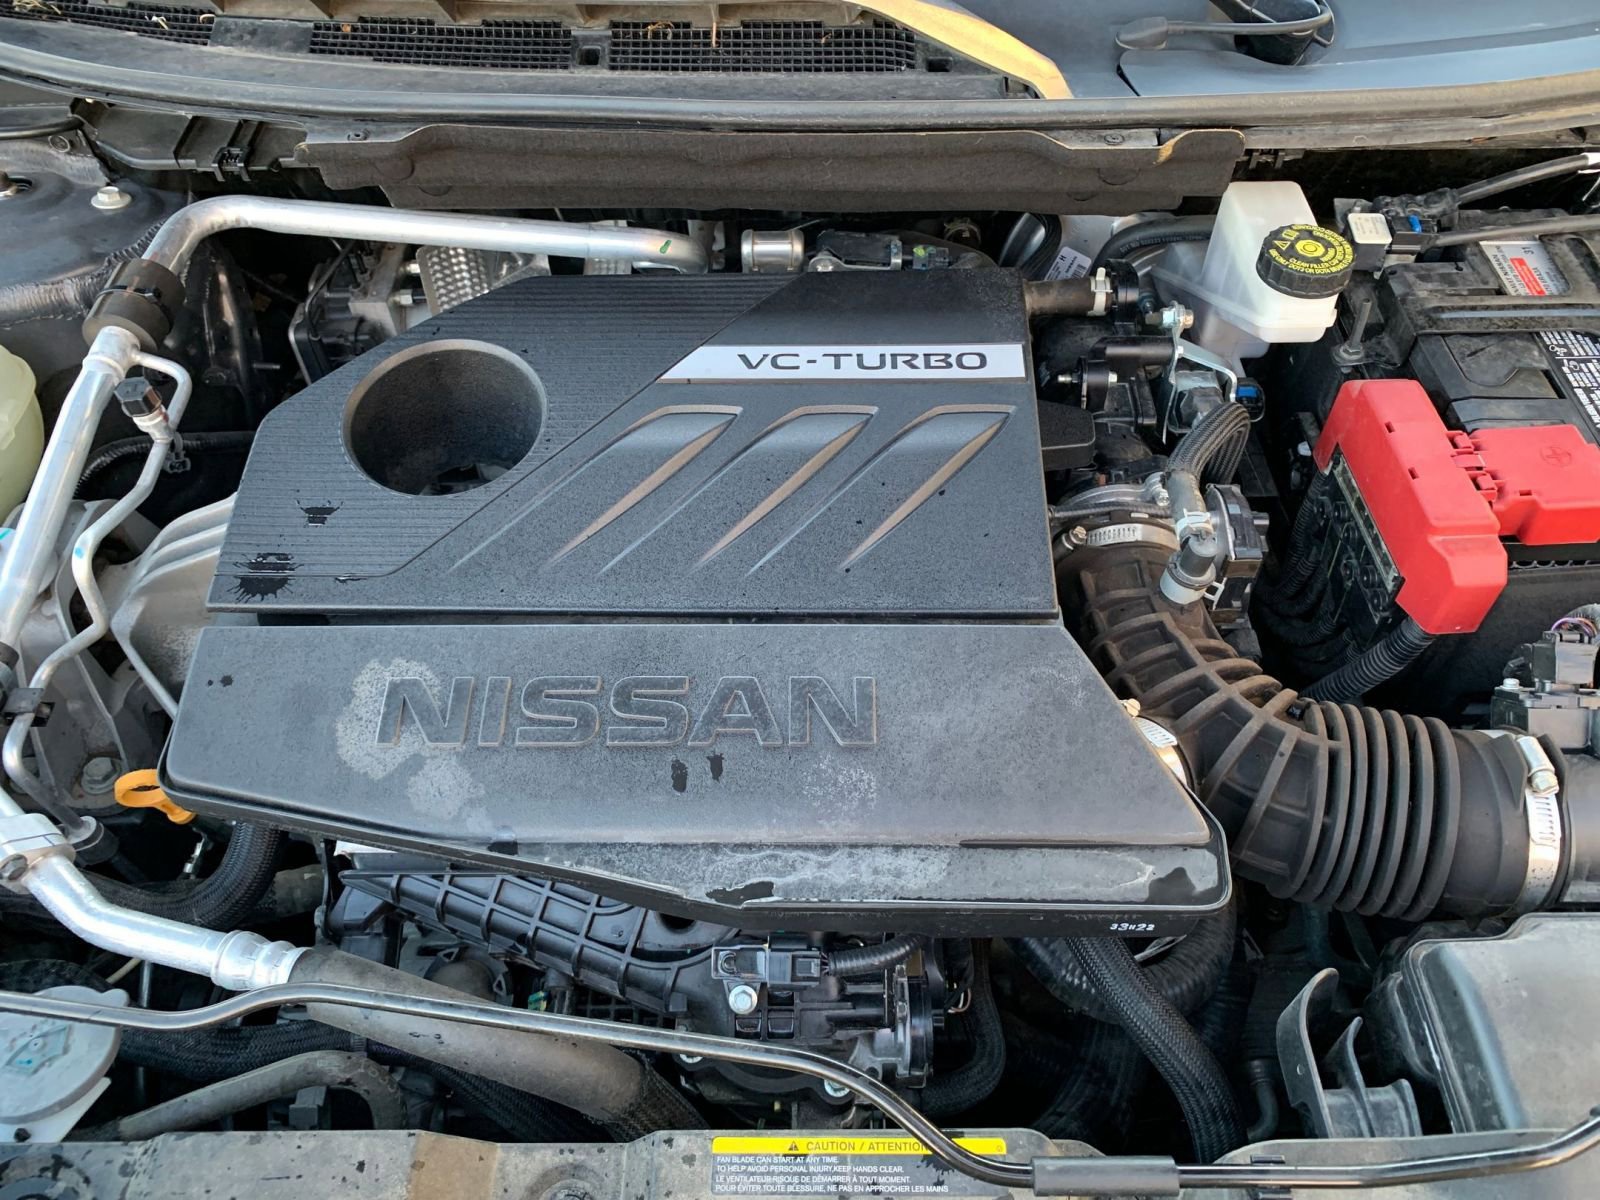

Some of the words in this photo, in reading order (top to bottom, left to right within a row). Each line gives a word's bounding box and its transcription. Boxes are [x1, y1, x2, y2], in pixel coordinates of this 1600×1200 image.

[737, 352, 988, 370] VC-TURBO
[375, 676, 877, 747] NISSAN
[806, 1141, 855, 1151] CAUTION
[717, 1165, 726, 1173] TO
[728, 1165, 746, 1173] HELP
[747, 1165, 768, 1173] AVOID
[770, 1165, 808, 1173] PERSONAL
[853, 1165, 877, 1173] HANDS
[716, 1175, 725, 1183] LE
[773, 1175, 800, 1183] RISQUE
[801, 1175, 811, 1183] DE
[860, 1175, 877, 1183] TOUT
